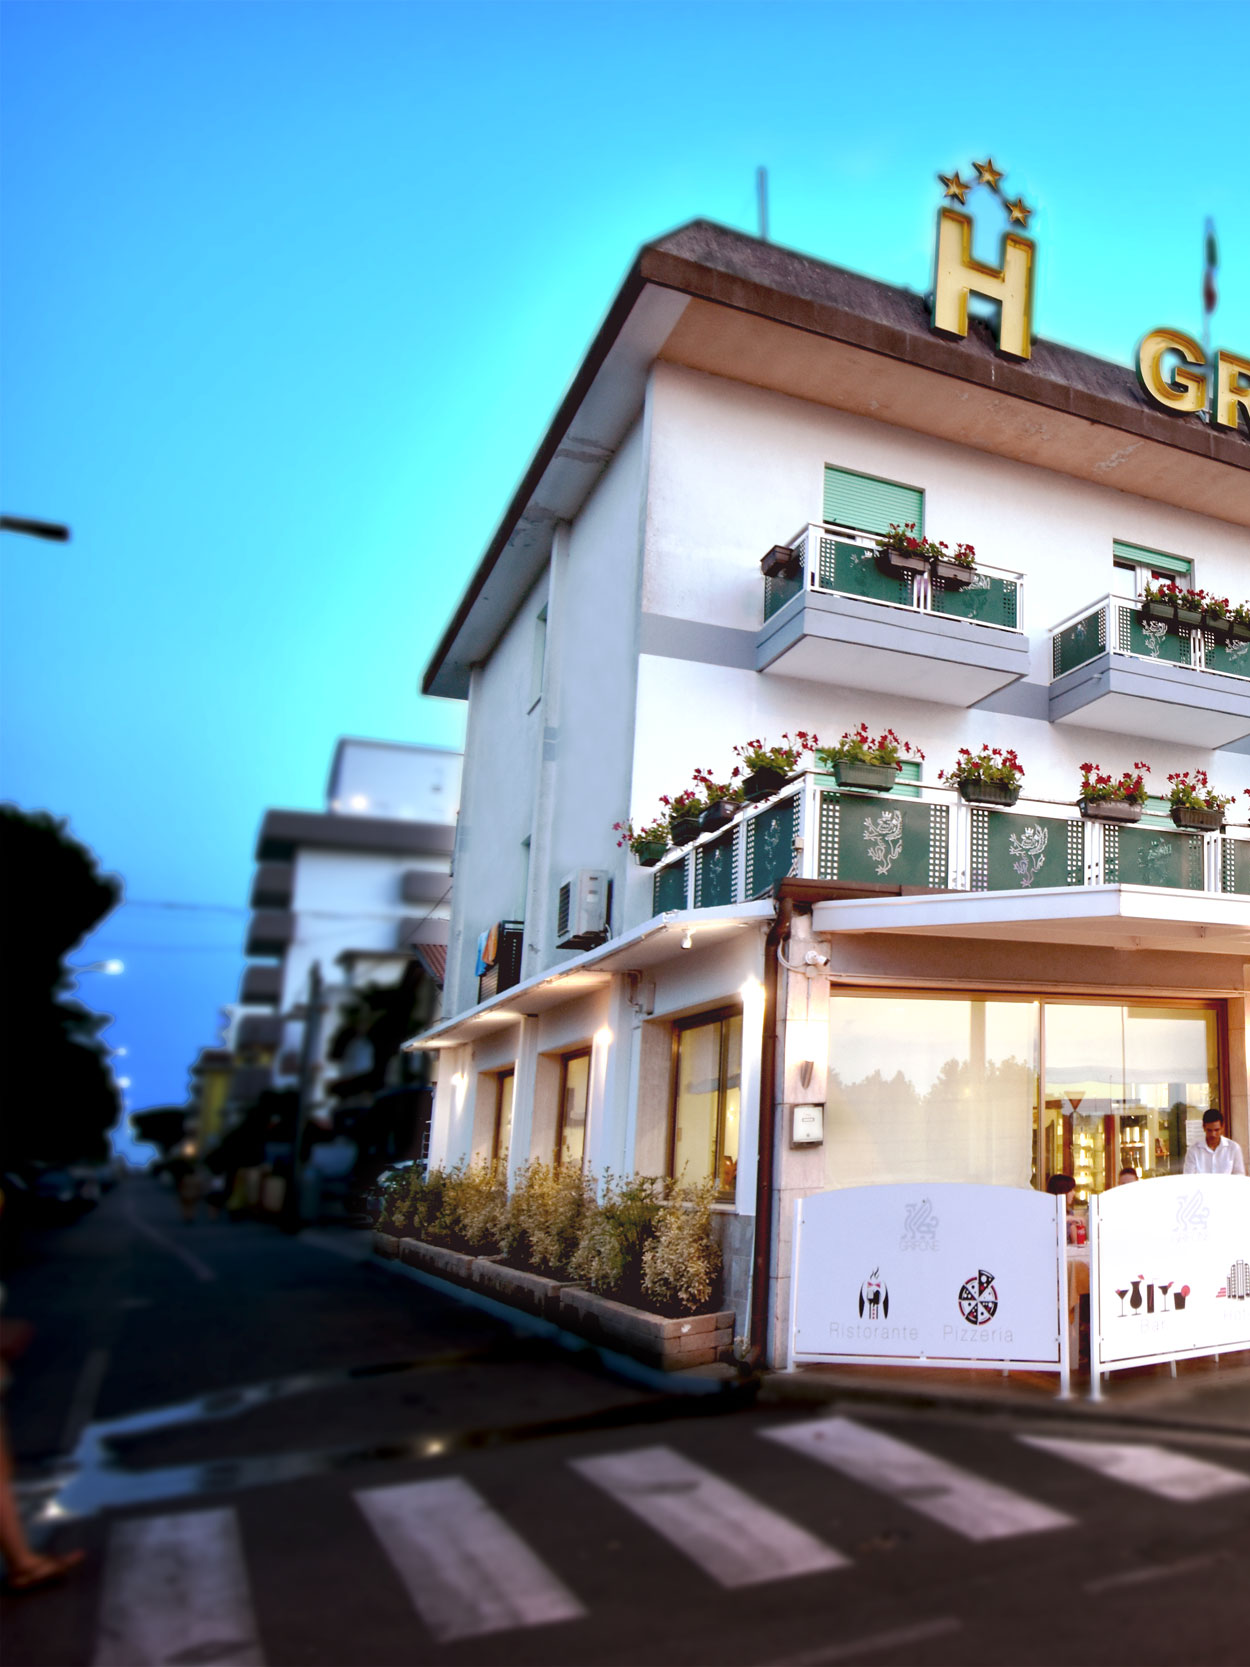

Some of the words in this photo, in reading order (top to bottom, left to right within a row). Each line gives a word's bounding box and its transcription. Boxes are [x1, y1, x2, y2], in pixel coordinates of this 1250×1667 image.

[930, 206, 1036, 363] H
[828, 1321, 919, 1341] Ristorante
[942, 1324, 1014, 1343] Pizzeria
